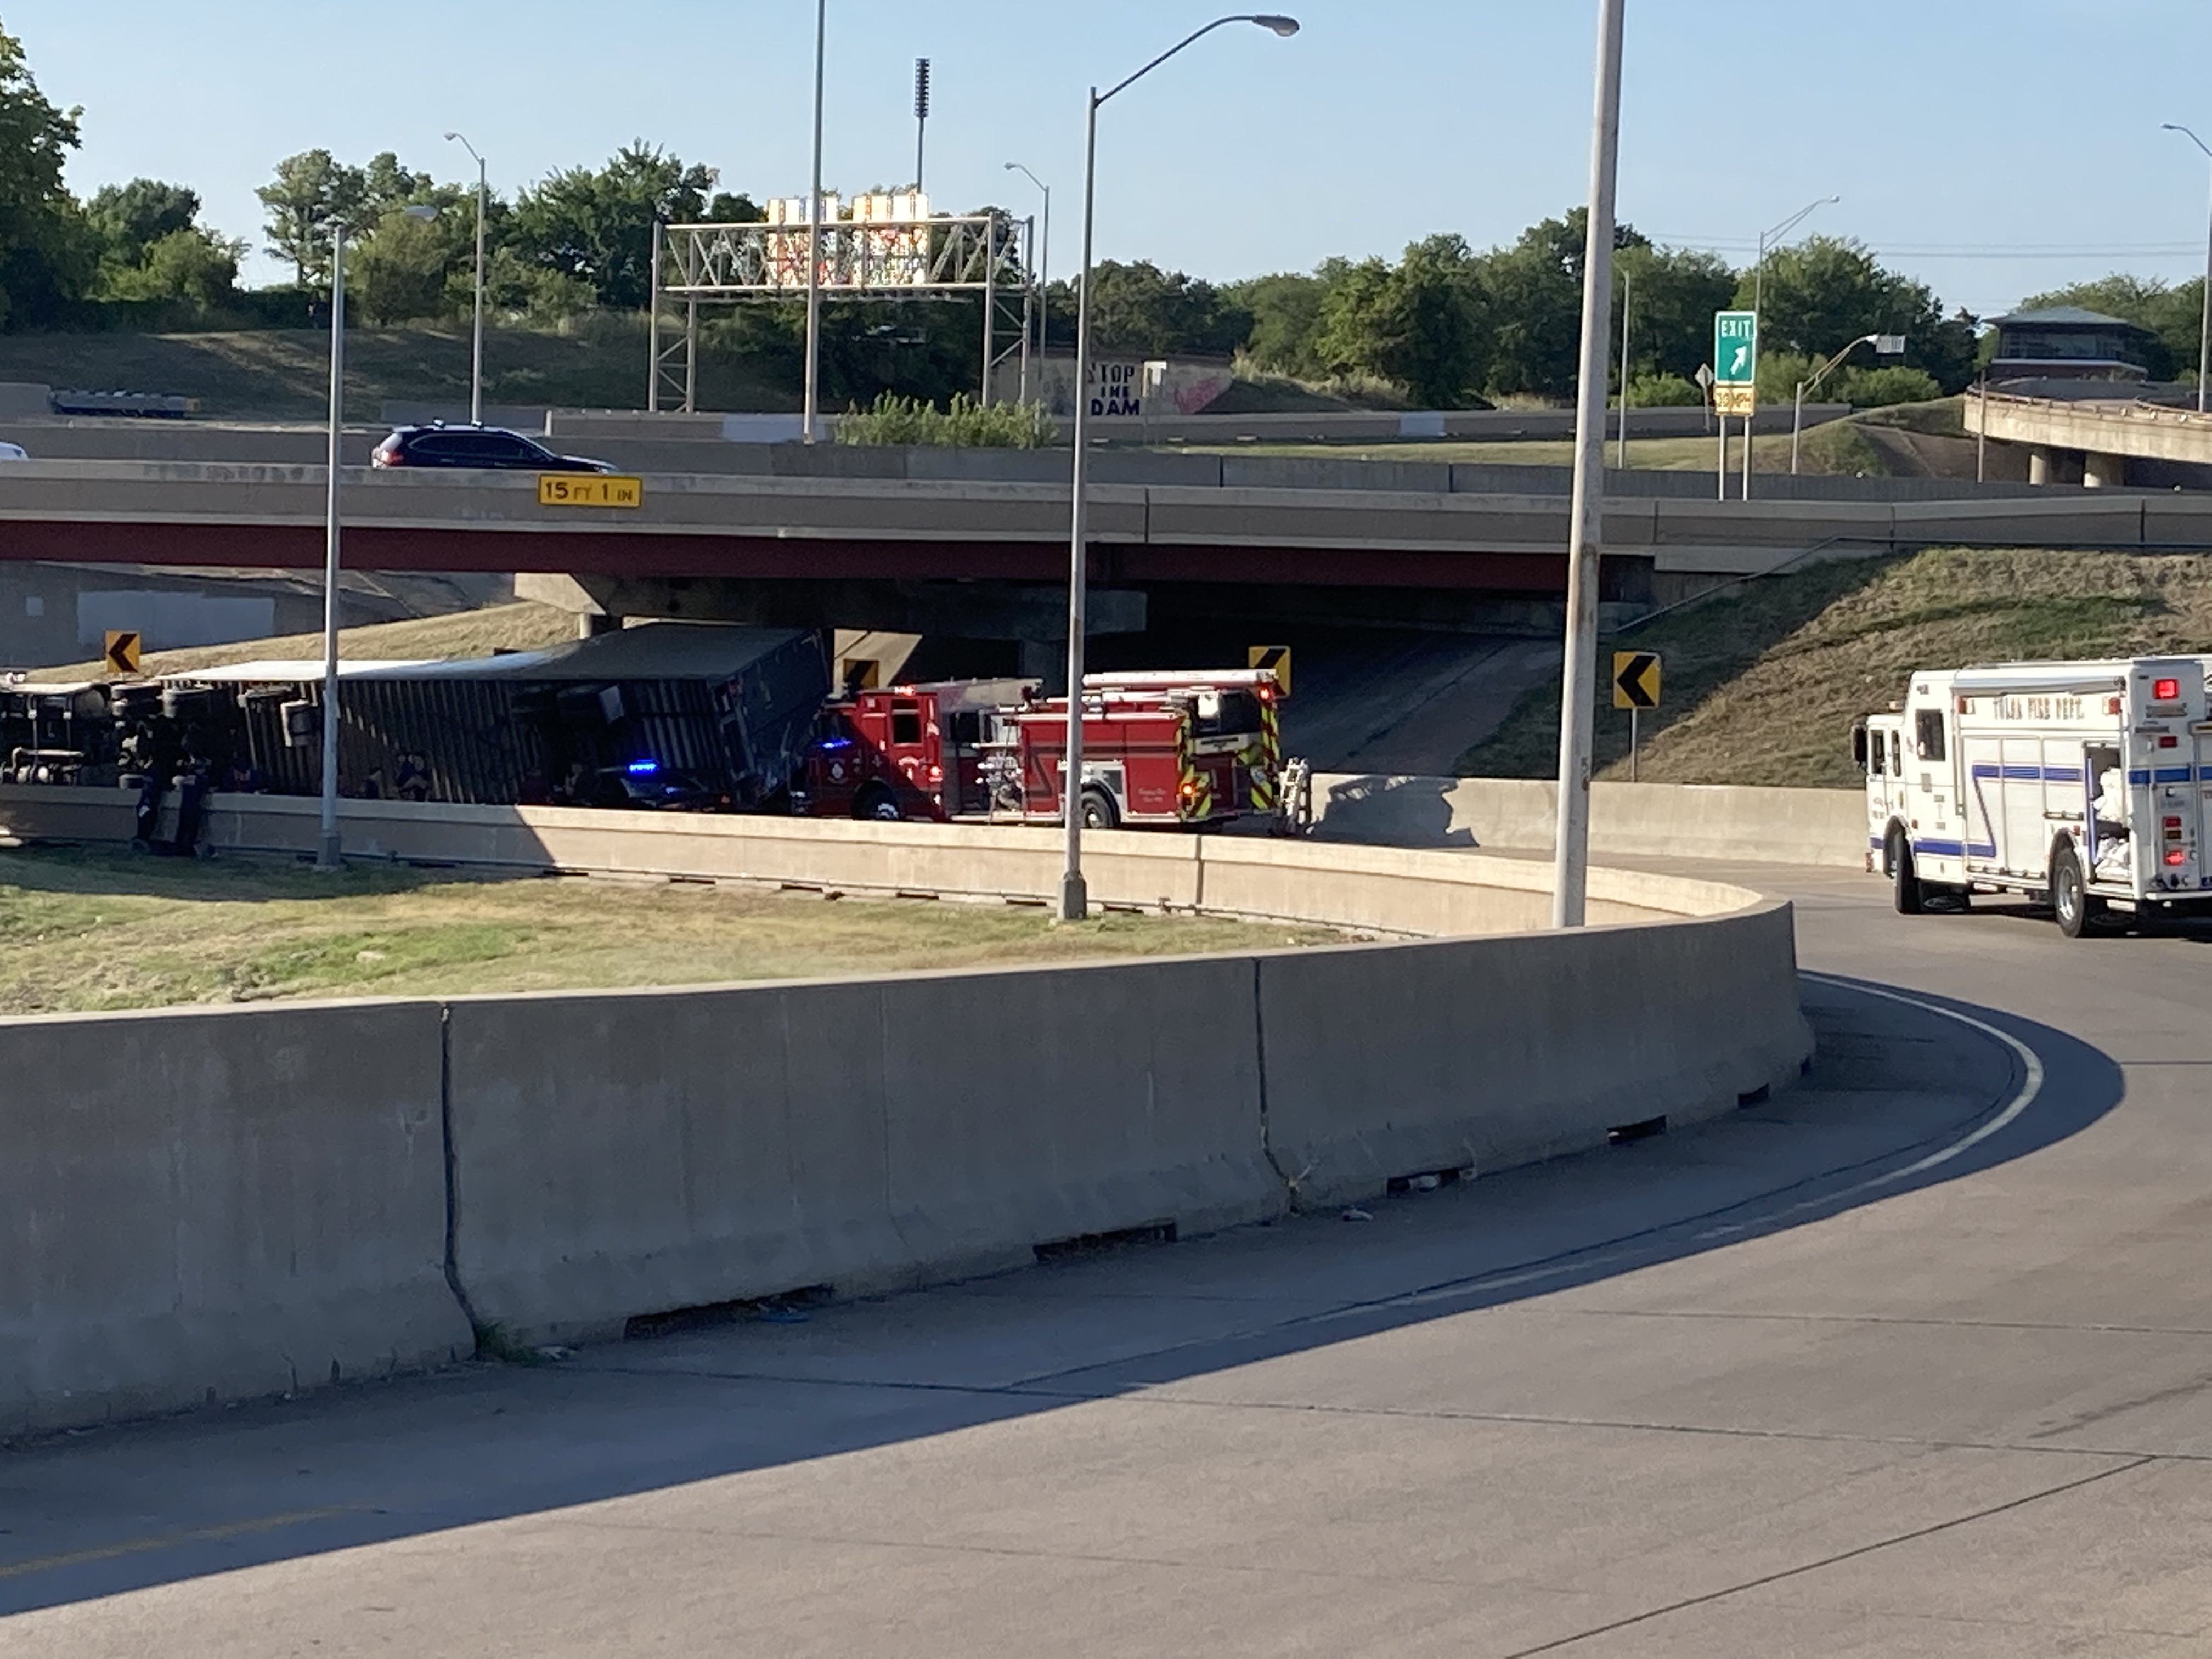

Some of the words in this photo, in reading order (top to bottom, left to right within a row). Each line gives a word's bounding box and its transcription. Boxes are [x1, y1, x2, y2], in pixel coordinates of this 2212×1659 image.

[1721, 320, 1751, 337] EXIT
[1088, 363, 1135, 383] STOP
[1091, 398, 1139, 415] DAM
[546, 482, 568, 499] 15
[602, 483, 608, 501] 1
[617, 489, 633, 501] IN
